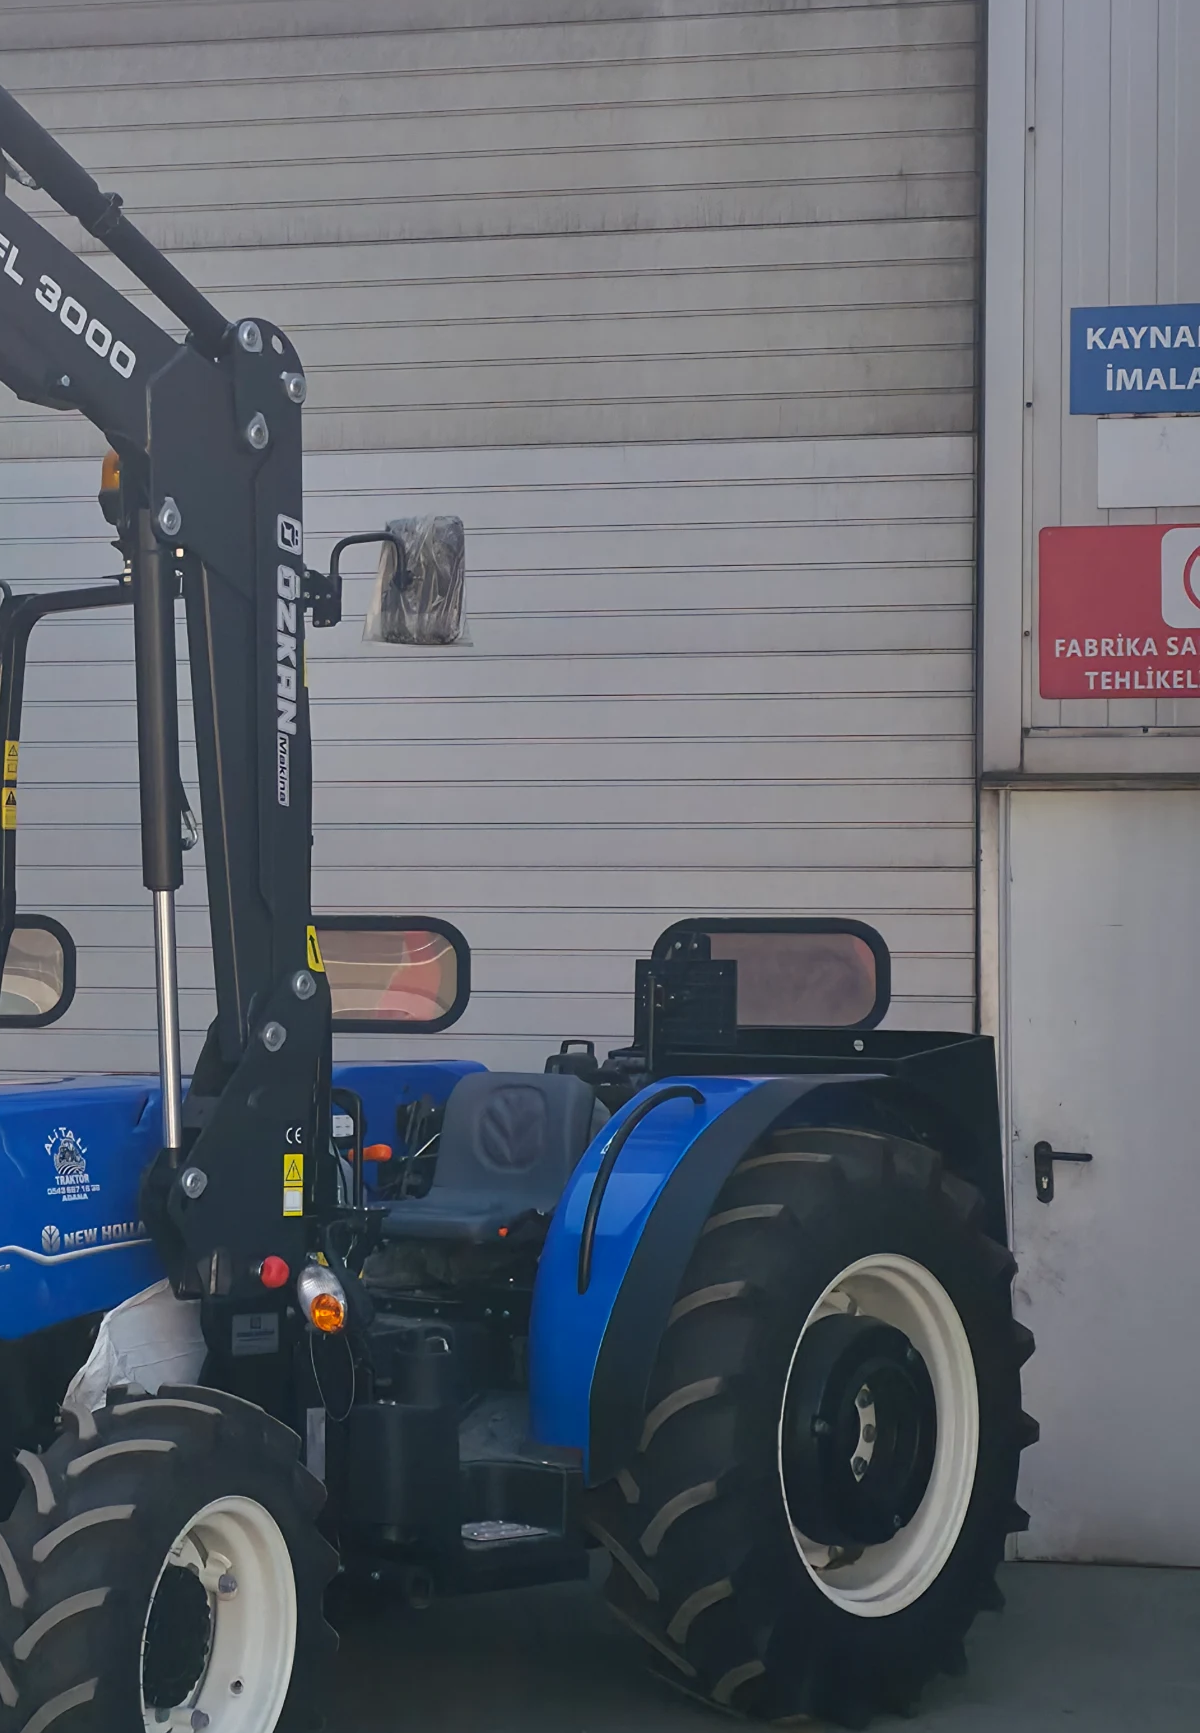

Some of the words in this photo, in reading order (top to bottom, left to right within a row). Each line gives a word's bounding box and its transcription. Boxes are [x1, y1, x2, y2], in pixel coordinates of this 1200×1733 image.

[35, 274, 137, 379] 3000
[1086, 326, 1200, 350] KAYNA
[277, 564, 300, 735] ÖZKAN
[1055, 633, 1158, 658] FABRİKA
[1166, 636, 1200, 656] SA
[1085, 666, 1200, 690] TEHLİKEL
[278, 735, 288, 802] Makina
[64, 1228, 98, 1248] NEW
